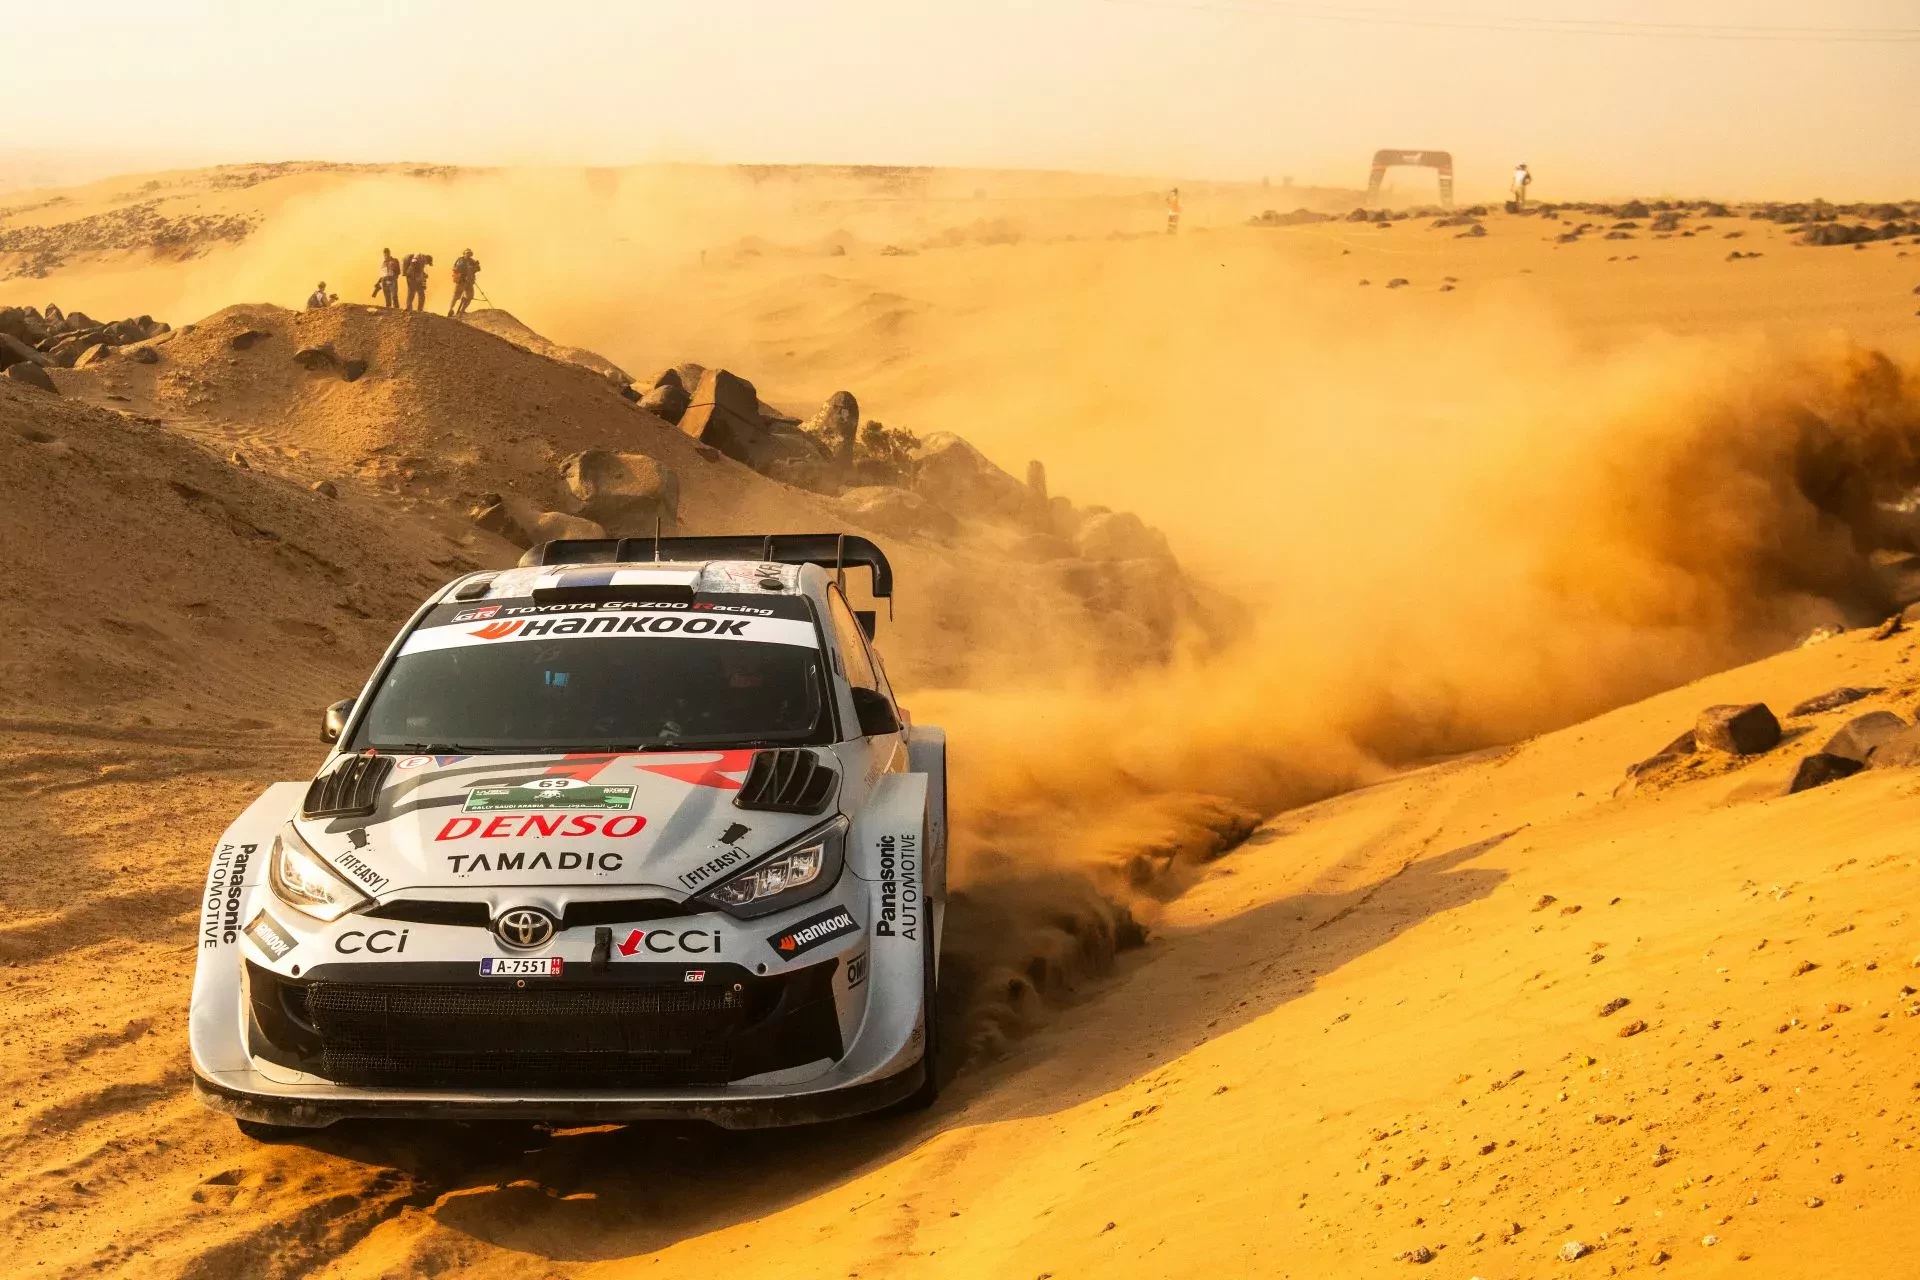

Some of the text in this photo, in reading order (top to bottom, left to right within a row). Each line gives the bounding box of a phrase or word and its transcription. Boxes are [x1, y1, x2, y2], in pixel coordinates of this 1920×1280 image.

[505, 601, 775, 616] TOYOTA GAZOO Racing
[435, 814, 647, 841] DENSO
[447, 852, 623, 873] TAMADIC
[204, 844, 234, 949] AUTOMOTIVE
[223, 843, 258, 944] Panasonic
[876, 836, 896, 936] Panasonic
[901, 834, 916, 941] AUTOMOTIVE
[496, 961, 546, 972] A-7551
[684, 972, 704, 981] GR
